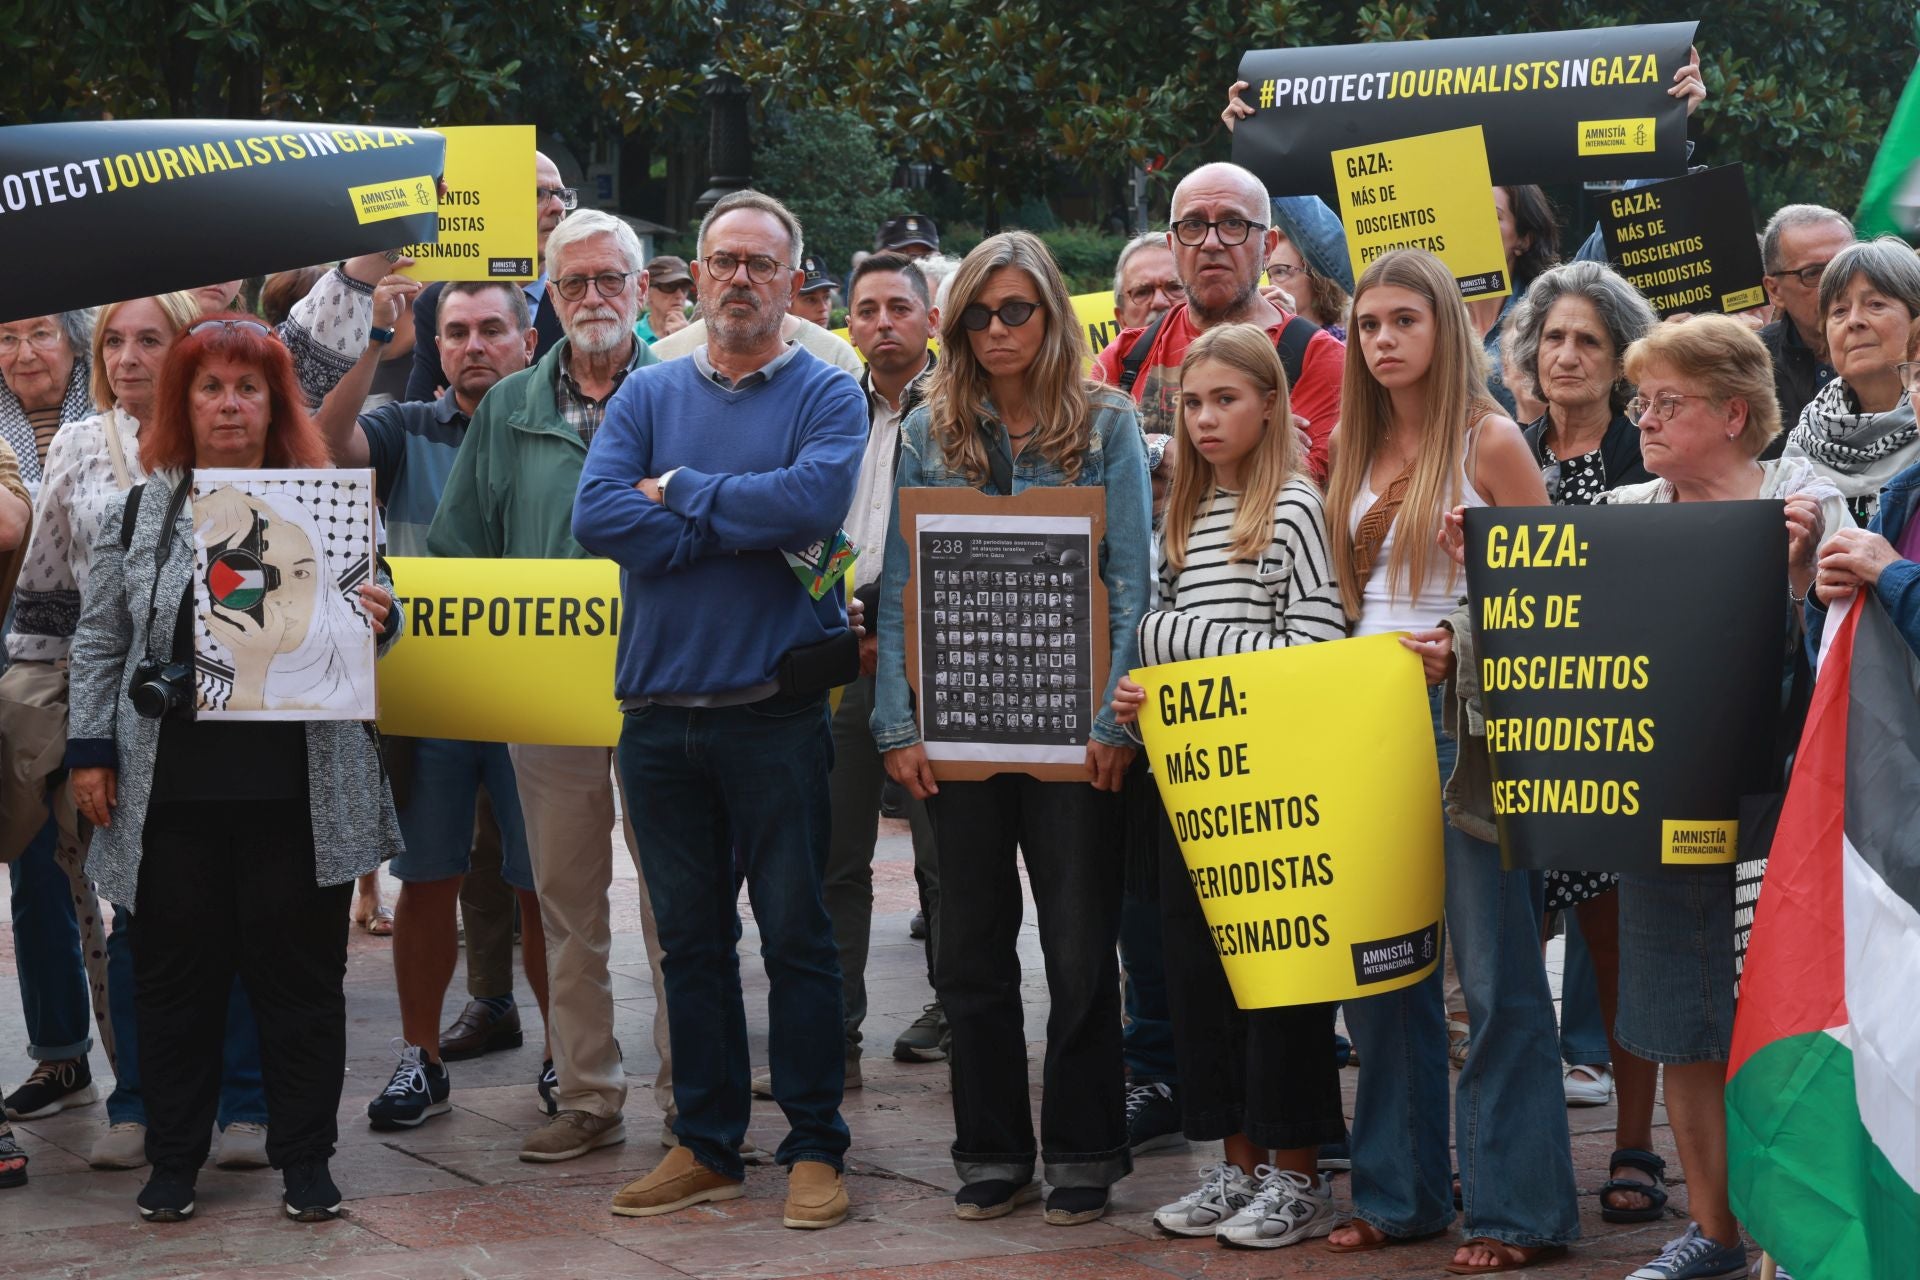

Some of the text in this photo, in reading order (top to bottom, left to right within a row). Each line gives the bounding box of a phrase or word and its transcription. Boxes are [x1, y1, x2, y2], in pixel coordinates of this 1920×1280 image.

[1260, 54, 1658, 108] #PROTECTJOURNALISTSINGAZA
[1586, 125, 1626, 139] AMNISTÍA
[1586, 139, 1626, 147] INTERNACIONAL
[0, 128, 414, 213] OTECTJOURNALISTSINGAZA
[1346, 152, 1393, 178] GAZA:
[361, 187, 406, 205] AMNISTÍA
[364, 200, 410, 214] INTERNACIONAL
[1351, 185, 1397, 207] MÁS DE
[1611, 192, 1661, 218] GAZA:
[1356, 208, 1436, 235] DOSCIENTOS
[1617, 219, 1666, 243] MÁS DE
[1622, 236, 1703, 267] DOSCIENTOS
[1628, 259, 1712, 289] PERIODISTAS
[932, 540, 963, 554] 238
[1486, 524, 1589, 569] GAZA:
[1483, 588, 1582, 630] MÁS DE
[1483, 655, 1649, 692] DOSCIENTOS
[1159, 675, 1247, 726] GAZA:
[1486, 717, 1655, 753] PERIODISTAS
[1166, 743, 1250, 785] MÁS DE
[1176, 794, 1320, 842] DOSCIENTOS
[1672, 828, 1726, 843] AMNISTÍA
[1672, 846, 1726, 854] INTERNACIONAL
[1363, 941, 1414, 965] AMNISTÍA
[1364, 956, 1415, 975] INTERNACIONAL
